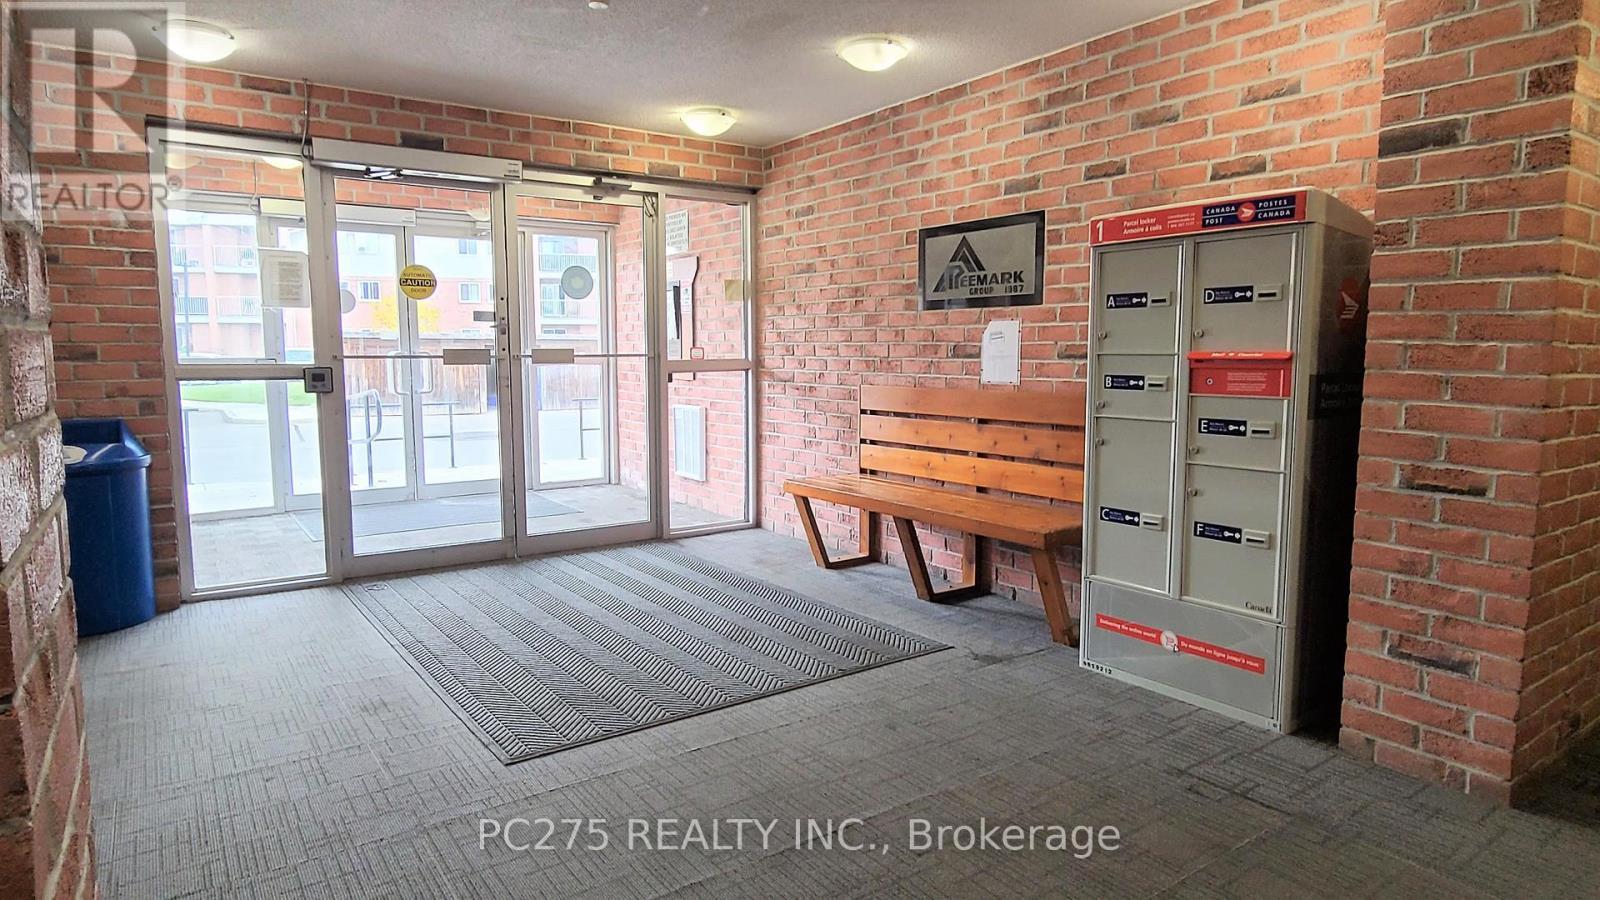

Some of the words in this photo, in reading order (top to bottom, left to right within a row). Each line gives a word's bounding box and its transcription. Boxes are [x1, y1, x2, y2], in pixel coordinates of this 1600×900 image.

[1259, 199, 1288, 208] POSTES
[1206, 206, 1236, 215] CANADA
[1258, 209, 1291, 219] CANADA
[1123, 218, 1139, 227] Parcel
[1139, 217, 1157, 225] locker
[1205, 217, 1223, 225] POST
[1096, 220, 1104, 242] 1
[1123, 226, 1144, 235] Armoire
[1149, 224, 1163, 232] colis
[400, 278, 436, 287] CAUTION
[969, 287, 994, 295] GROUP
[1004, 285, 1024, 294] 1987
[1205, 290, 1215, 302] D
[1107, 296, 1116, 308] A
[1105, 376, 1112, 388] B
[1201, 420, 1208, 432] E
[1102, 508, 1109, 520] C
[1196, 524, 1204, 535] F
[1100, 618, 1120, 630] Delivering
